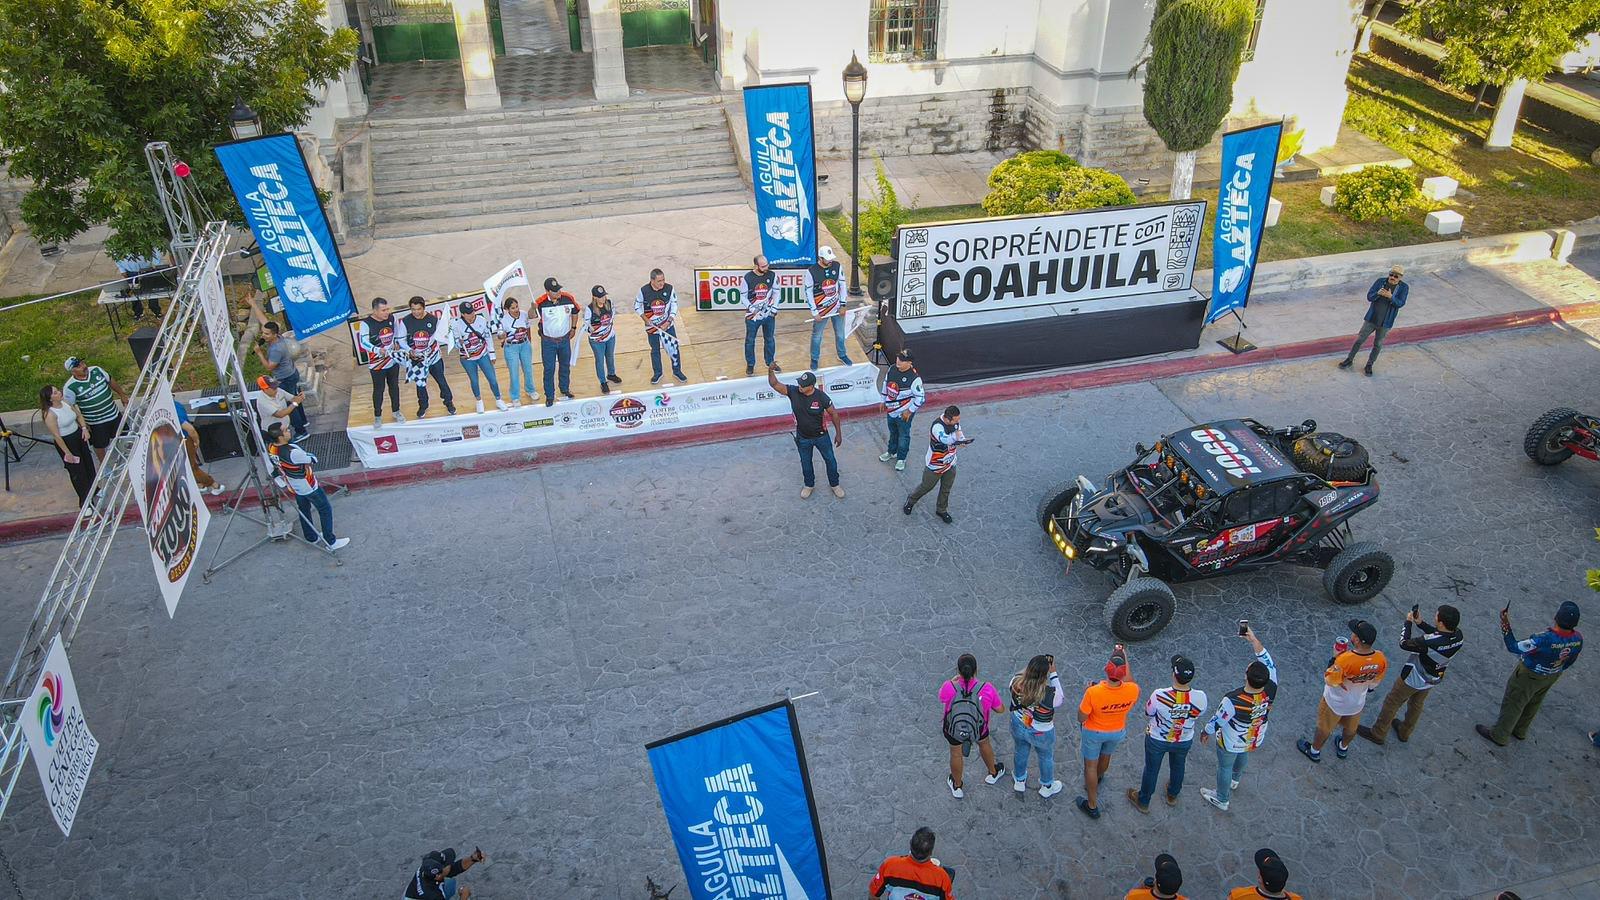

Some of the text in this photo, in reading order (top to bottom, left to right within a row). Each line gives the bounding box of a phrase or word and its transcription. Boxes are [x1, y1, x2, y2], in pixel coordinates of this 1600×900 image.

[756, 136, 774, 195] AGUILA
[766, 111, 799, 213] AZTECA
[245, 191, 283, 254] AGUILA
[249, 163, 318, 271] AZTECA
[1221, 181, 1233, 244] AGUILA
[1231, 152, 1256, 261] AZTECA
[933, 220, 1165, 265] SORPRÉNDETE con
[932, 249, 1160, 307] COAHUILA
[614, 413, 643, 424] 1000
[1319, 490, 1338, 508] 1969
[704, 762, 785, 900] ZTECA
